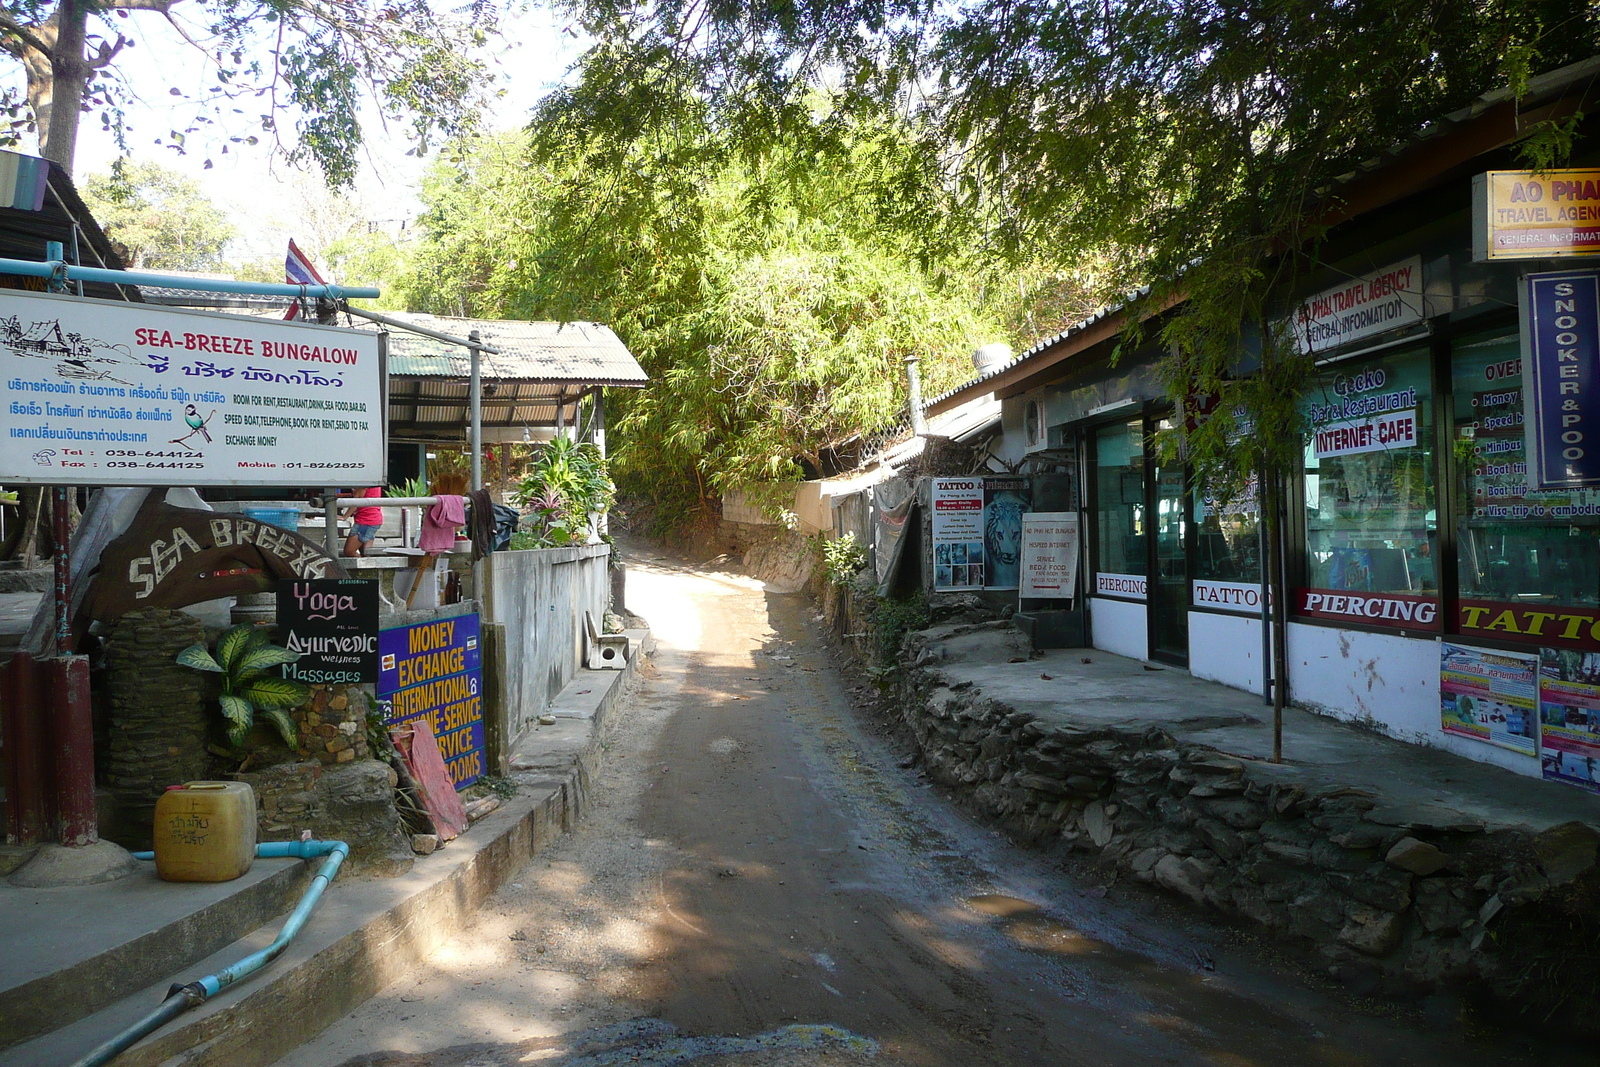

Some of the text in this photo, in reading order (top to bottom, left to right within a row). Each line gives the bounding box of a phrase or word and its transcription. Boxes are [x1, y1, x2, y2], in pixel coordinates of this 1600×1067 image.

[1510, 182, 1543, 202] AO
[1498, 206, 1600, 223] TRAVEL AGEN
[1499, 235, 1545, 244] GENERAL
[1313, 296, 1332, 320] PHAI
[1333, 284, 1366, 311] TRAVEL
[1369, 266, 1412, 301] AGENCY
[1342, 300, 1401, 334] INFORMATION
[135, 328, 357, 365] SEA-BREEZE BUNGALOW
[241, 366, 344, 387] บังกาโลว์
[1334, 366, 1385, 396] Gecko
[8, 378, 75, 393] บริการห้องพัก
[80, 382, 125, 397] ร้านอาหาร
[129, 383, 168, 400] เครื่องดื่ม
[1483, 391, 1517, 407] Money
[10, 401, 42, 415] เรือเร็ว
[46, 402, 84, 417] โทรศัพท์
[88, 406, 132, 419] เช่าหนังสือ
[233, 394, 250, 405] ROOM
[252, 395, 262, 406] FOR
[1311, 387, 1416, 422] Bar & Restaurant
[10, 422, 147, 442] แลกเปลี่ยนเงินตราต่างประเทศ
[224, 414, 242, 424] SPEED
[310, 418, 320, 428] FOR
[351, 421, 358, 430] TO
[359, 421, 369, 430] FAX
[1485, 415, 1512, 430] Speed
[226, 435, 277, 446] EXCHANGE MONEY
[1316, 417, 1412, 453] INTERNET CAFE
[106, 450, 204, 458] 038-644124
[1486, 441, 1521, 453] Minibus
[1487, 465, 1509, 476] Boat
[937, 482, 974, 490] TATTOO
[977, 482, 983, 490] &
[1488, 486, 1508, 497] Boat
[1512, 485, 1527, 497] trip
[1488, 505, 1507, 516] Visa
[1512, 504, 1528, 518] trip
[1534, 505, 1545, 516] to
[129, 527, 201, 600] SEA
[1099, 577, 1147, 594] PIERCING
[294, 583, 357, 620] Yoga
[1304, 593, 1437, 624] PIERCING
[1462, 606, 1600, 641] TATT
[409, 621, 454, 654] MONEY
[282, 663, 360, 684] Massages
[399, 647, 464, 687] EXCHANGE
[393, 674, 470, 719] INTERNATIONAL
